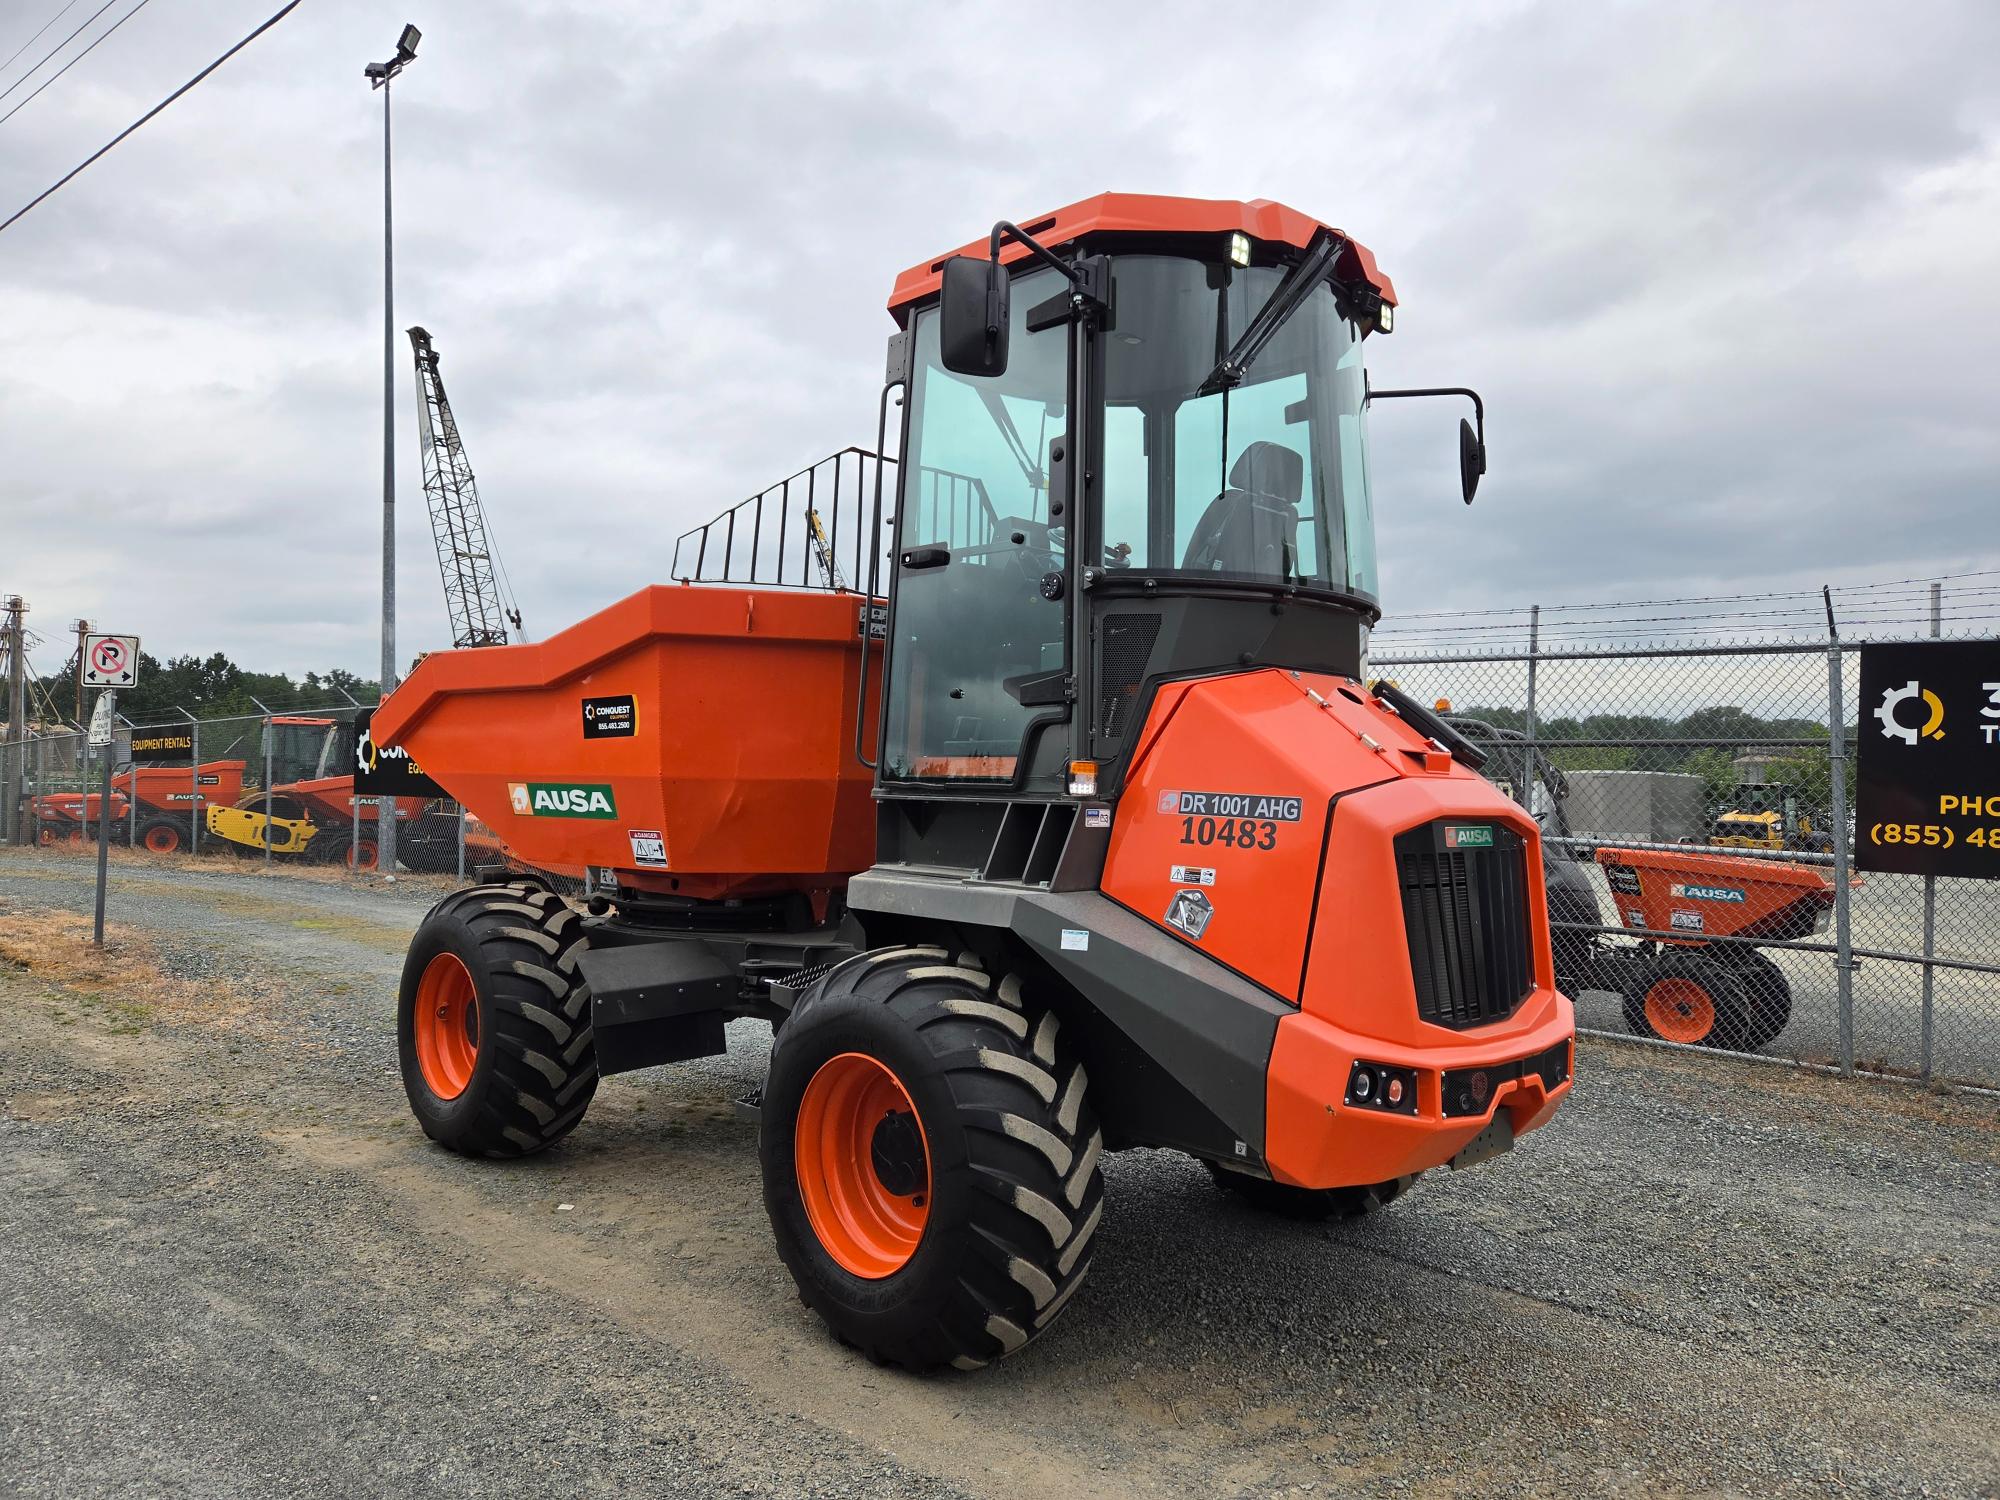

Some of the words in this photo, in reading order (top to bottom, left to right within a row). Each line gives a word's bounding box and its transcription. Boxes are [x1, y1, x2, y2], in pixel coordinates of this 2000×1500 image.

[596, 705, 631, 716] CONQUEST
[132, 738, 164, 751] EQUIPMENT
[164, 736, 191, 749] RENTALS
[534, 789, 613, 813] AUSA
[1180, 793, 1206, 814] DR
[1211, 796, 1250, 816] 1001
[1254, 798, 1299, 819] AHG
[1180, 816, 1277, 851] 10483
[1457, 829, 1493, 843] AUSA
[1870, 823, 1955, 849] (855)
[1686, 886, 1744, 901] AUSA
